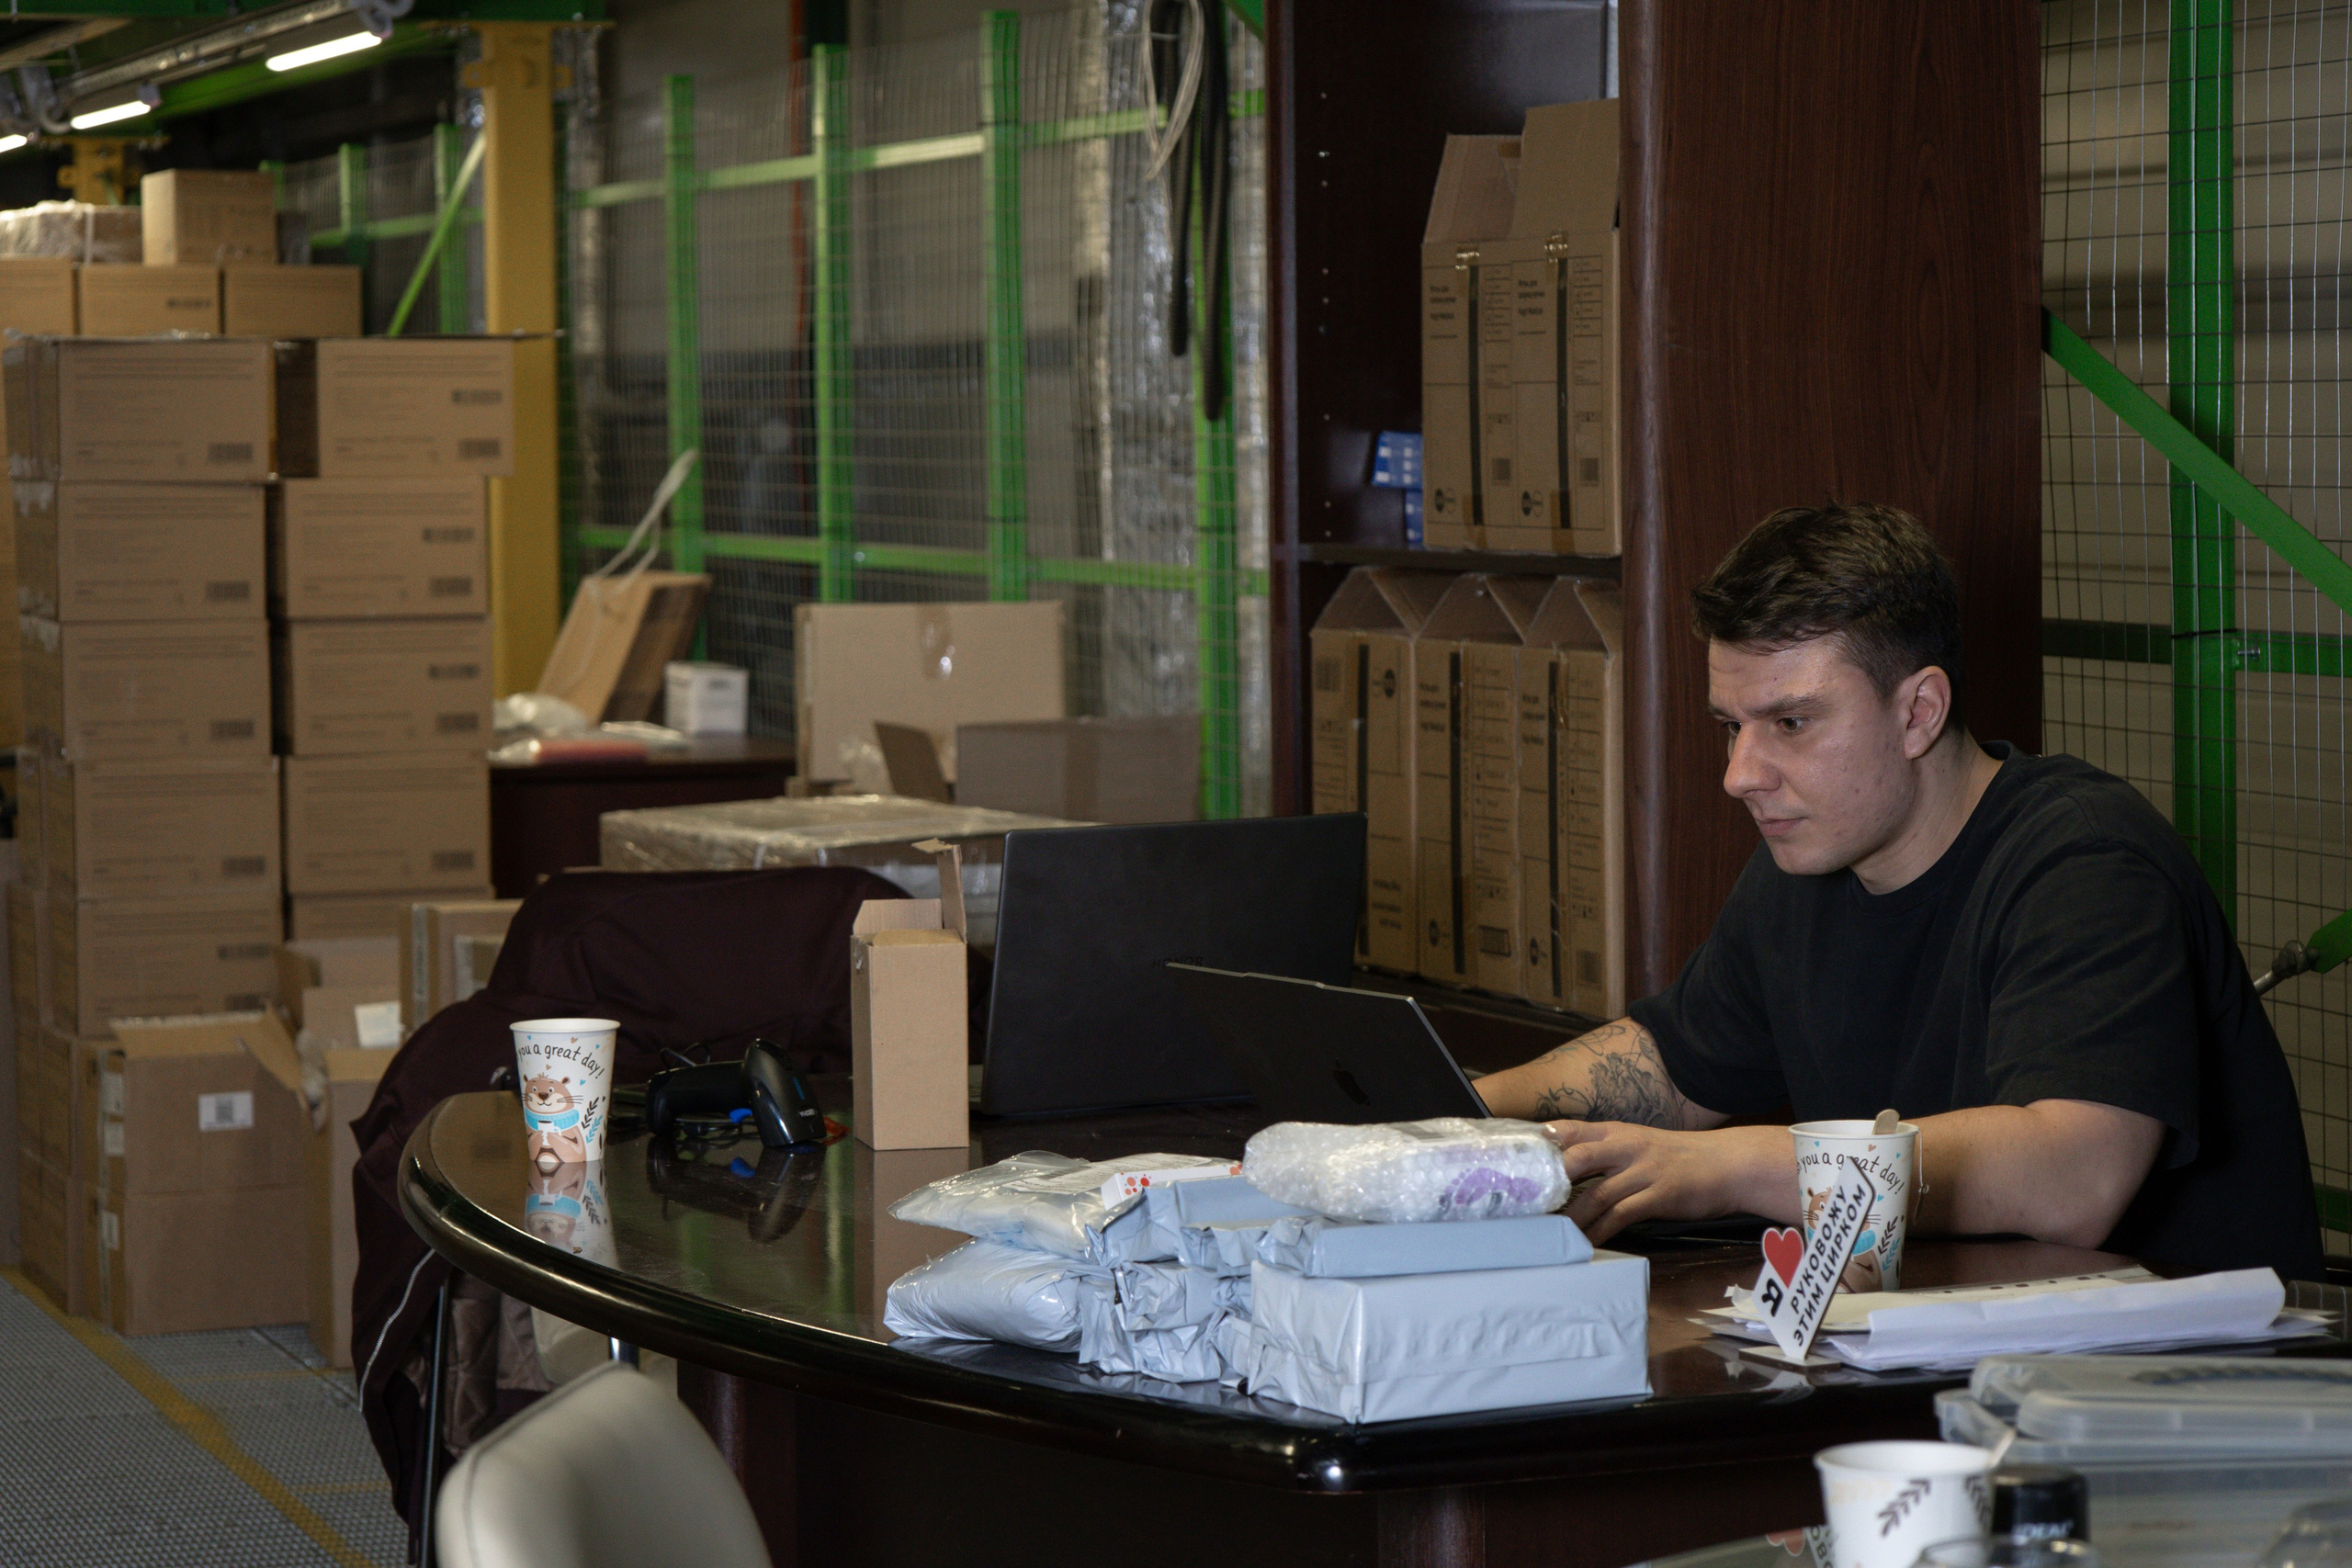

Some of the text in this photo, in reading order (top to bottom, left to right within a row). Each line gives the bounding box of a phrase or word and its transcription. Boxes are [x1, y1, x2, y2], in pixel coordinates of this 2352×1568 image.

[518, 1043, 605, 1079] you a great day!
[1800, 1153, 1820, 1174] you
[1822, 1152, 1833, 1166] a
[1879, 1163, 1905, 1195] day!
[1791, 1186, 1847, 1314] РУКОВОЖУ
[1793, 1184, 1866, 1347] ЭТИМ ЦИРКОМ
